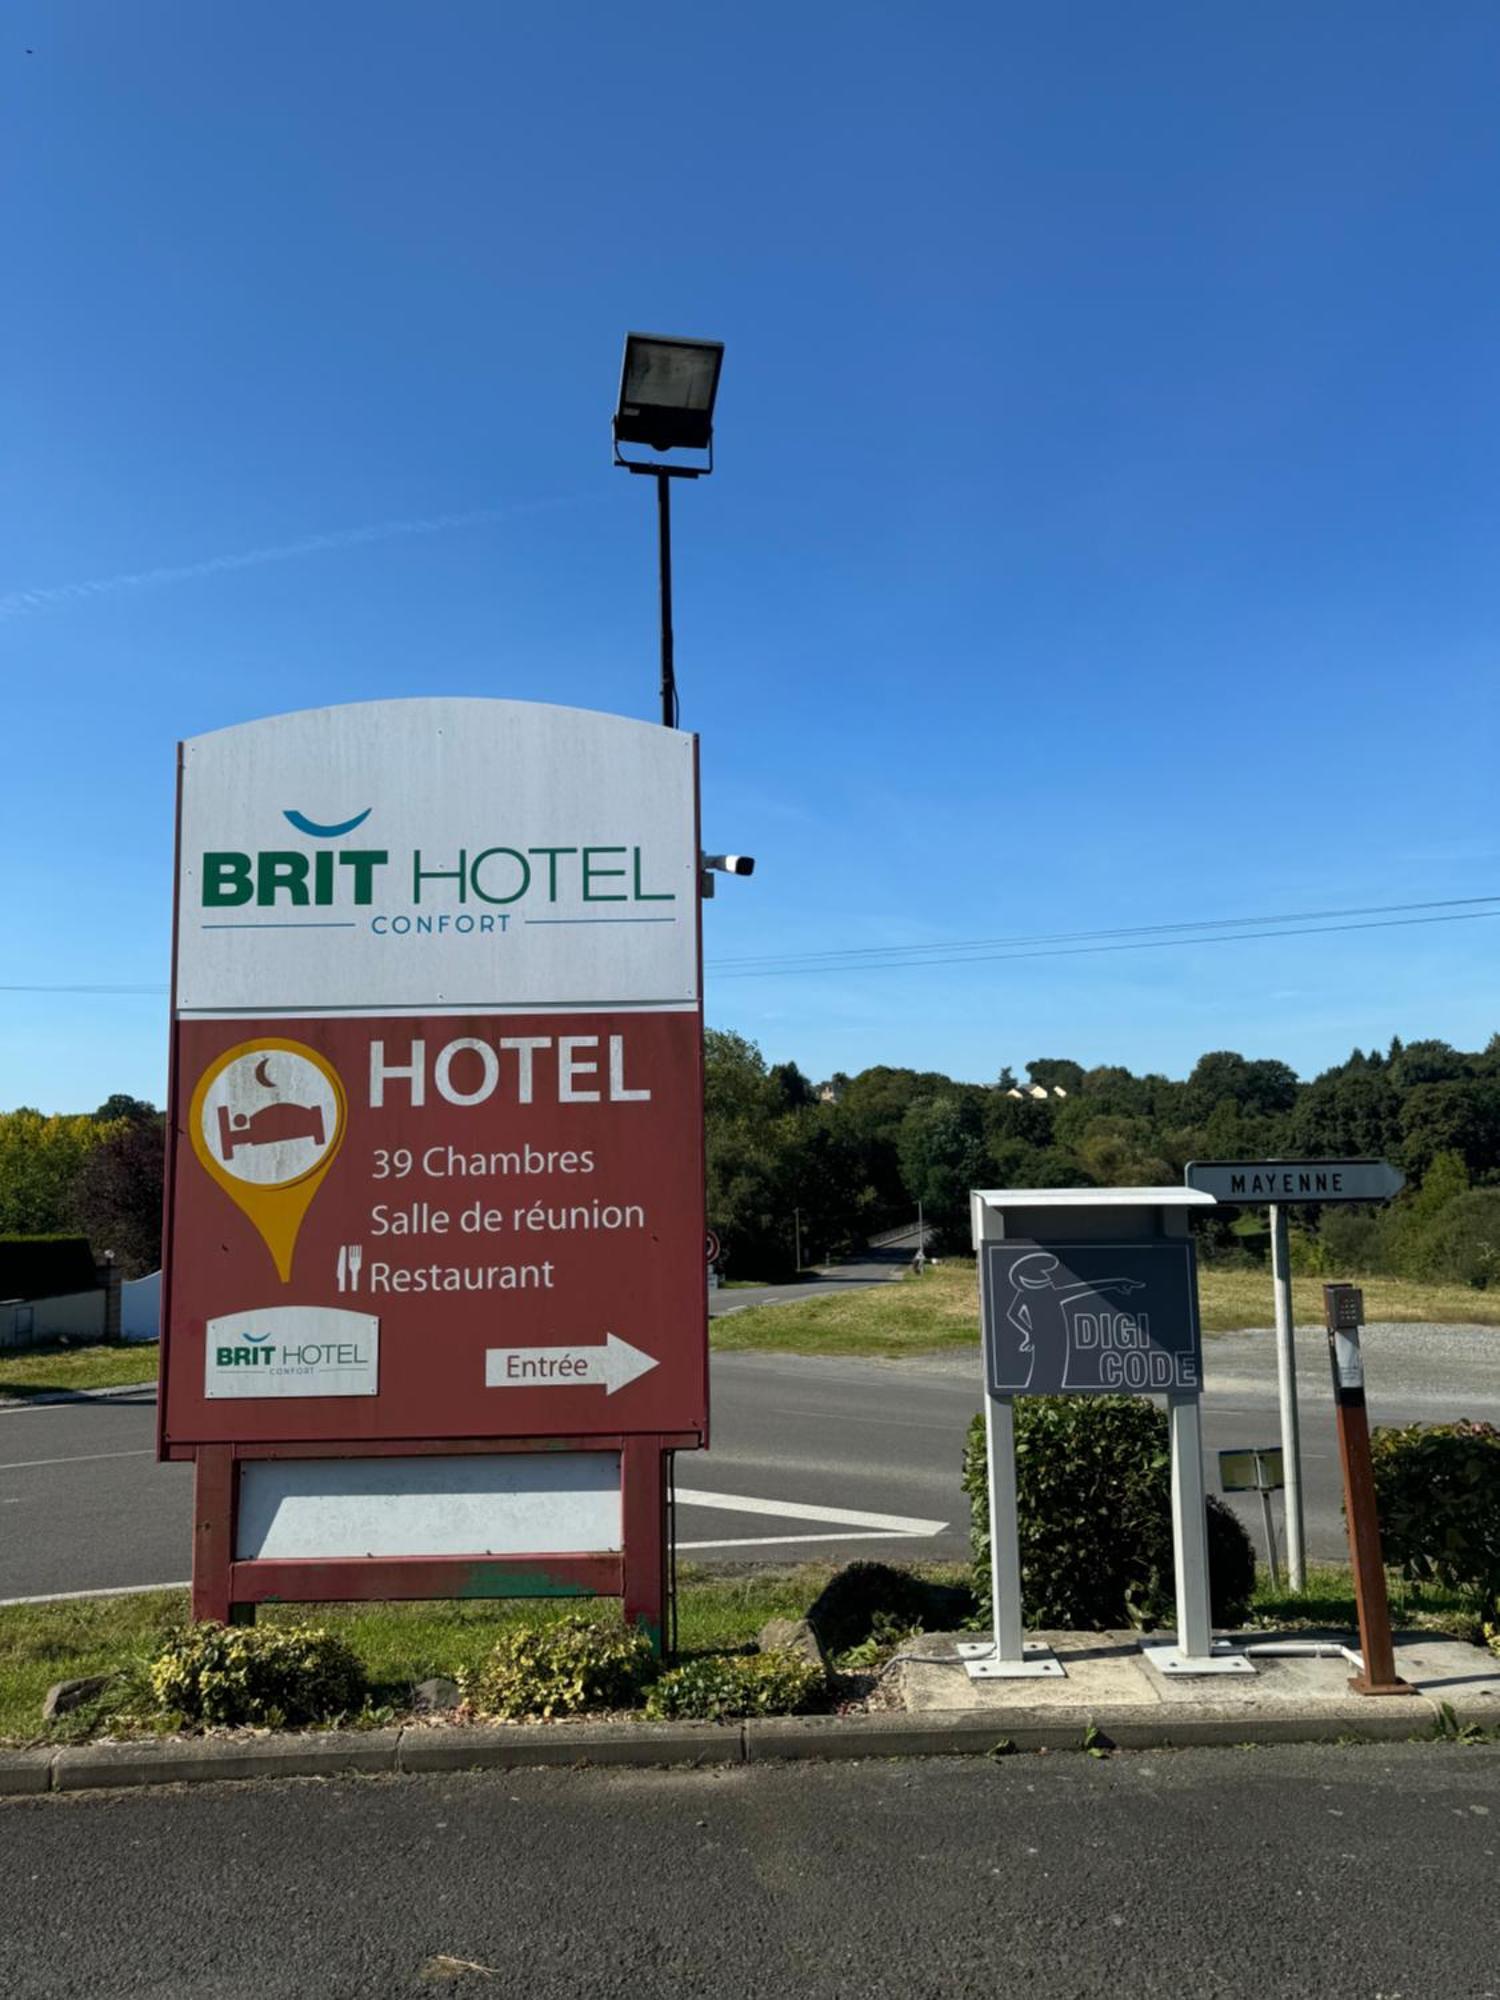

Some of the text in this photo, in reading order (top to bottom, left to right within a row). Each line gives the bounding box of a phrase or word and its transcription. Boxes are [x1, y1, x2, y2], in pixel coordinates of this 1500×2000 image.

[202, 846, 675, 907] BRIT HOTEL
[372, 914, 511, 935] CONFORT
[370, 1035, 651, 1108] HOTEL
[372, 1144, 595, 1179] 39 Chambres
[1231, 1173, 1342, 1192] MAYENNE
[371, 1199, 645, 1235] Salle de réunion
[371, 1260, 554, 1292] Restaurant
[1074, 1313, 1150, 1349] DIGI
[216, 1344, 368, 1366] BRIT HOTEL
[269, 1367, 315, 1376] CONFORT
[506, 1354, 588, 1379] Entrée
[1100, 1351, 1198, 1388] CODE
